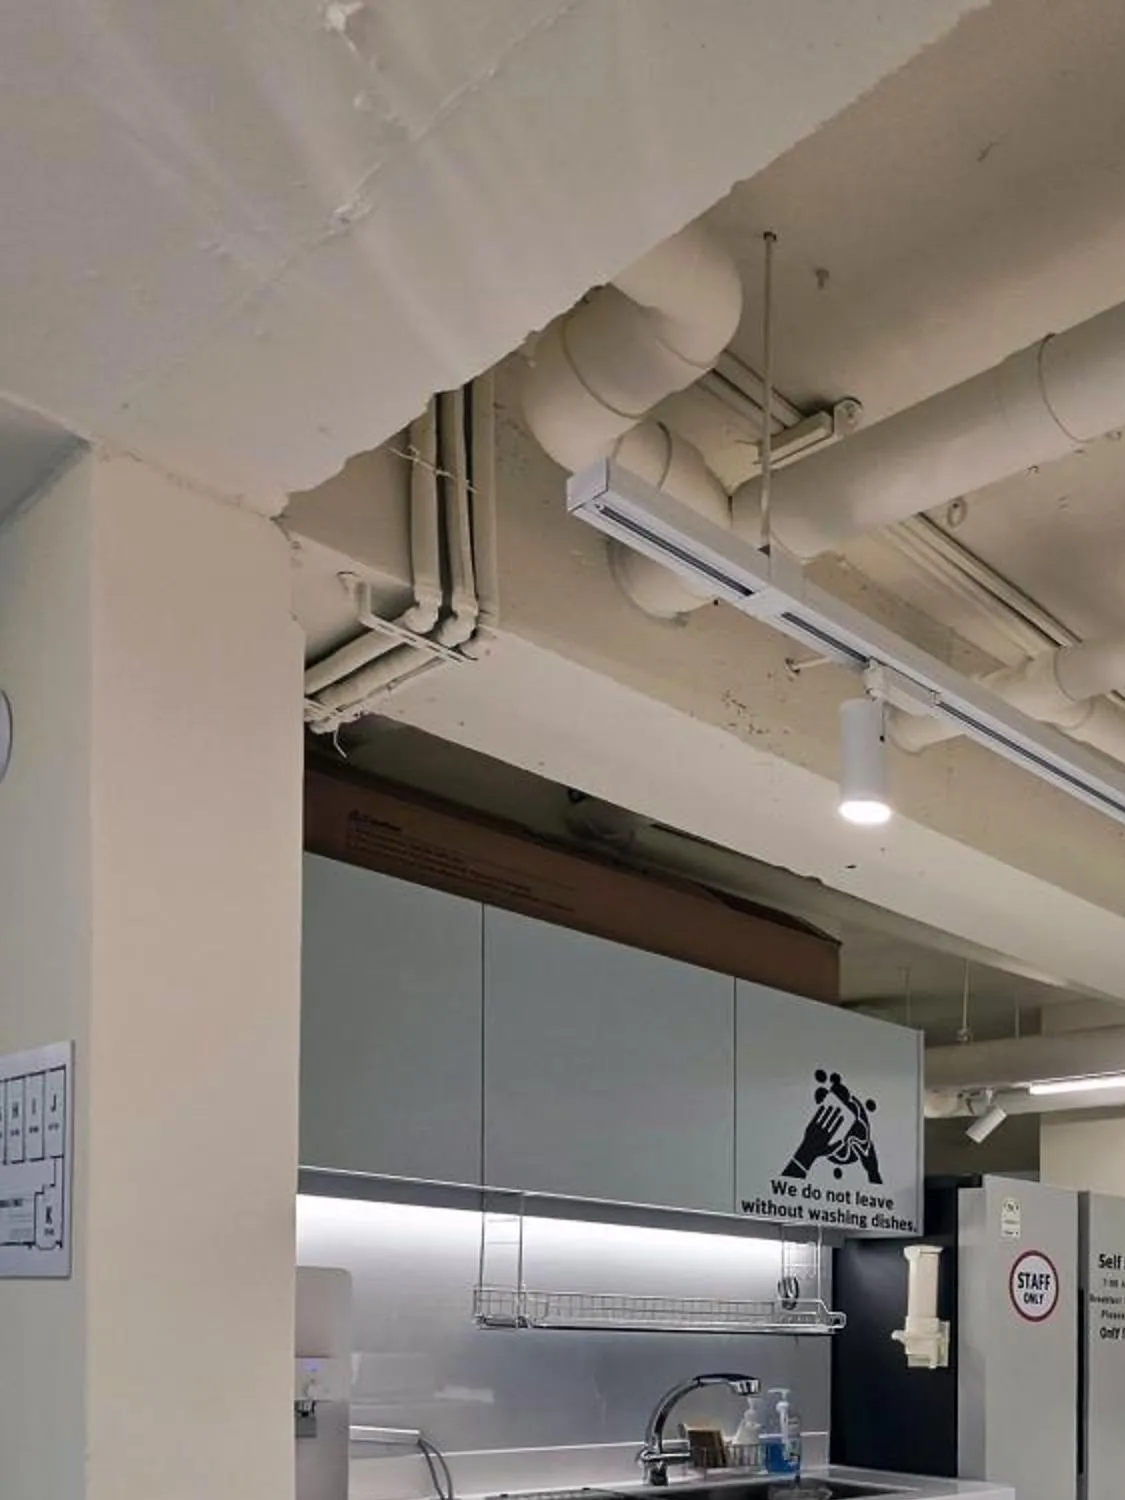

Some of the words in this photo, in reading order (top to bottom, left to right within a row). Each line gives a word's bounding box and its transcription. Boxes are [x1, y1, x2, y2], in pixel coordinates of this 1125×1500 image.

[771, 1180, 797, 1197] We
[802, 1184, 821, 1200] do
[826, 1190, 851, 1205] not
[856, 1192, 894, 1211] leave
[741, 1199, 804, 1219] without
[808, 1208, 868, 1229] washing
[872, 1213, 917, 1232] dishes.
[1099, 1253, 1121, 1270] Self
[1017, 1272, 1051, 1290] STAFF
[1023, 1293, 1044, 1304] ONLY
[1101, 1309, 1125, 1320] Please
